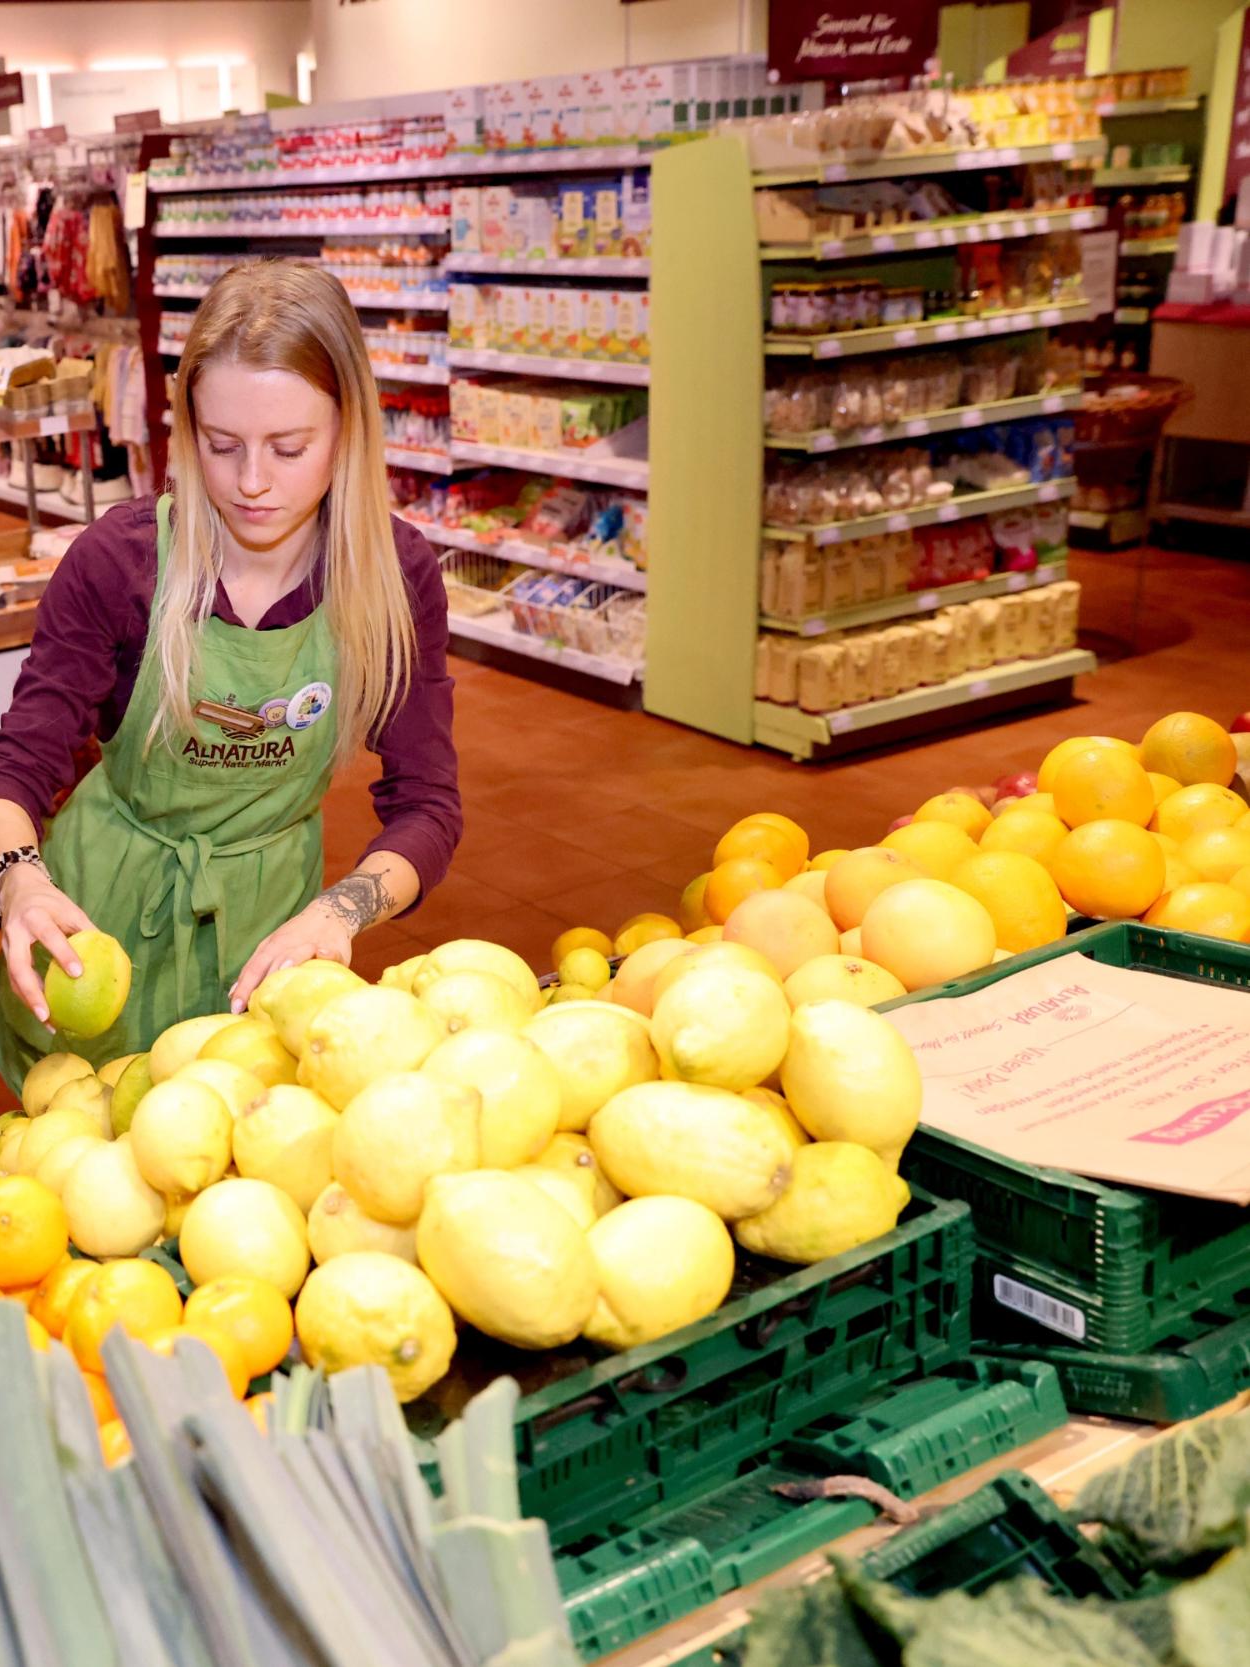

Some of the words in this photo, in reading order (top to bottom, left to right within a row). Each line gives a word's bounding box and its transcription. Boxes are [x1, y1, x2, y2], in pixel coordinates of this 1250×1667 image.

[181, 736, 295, 761] ALNATURA
[188, 757, 220, 768] Super
[221, 758, 252, 769] Natur
[254, 758, 288, 769] Markt
[1006, 983, 1091, 1026] ALNATURA
[996, 1046, 1052, 1075] Vielen
